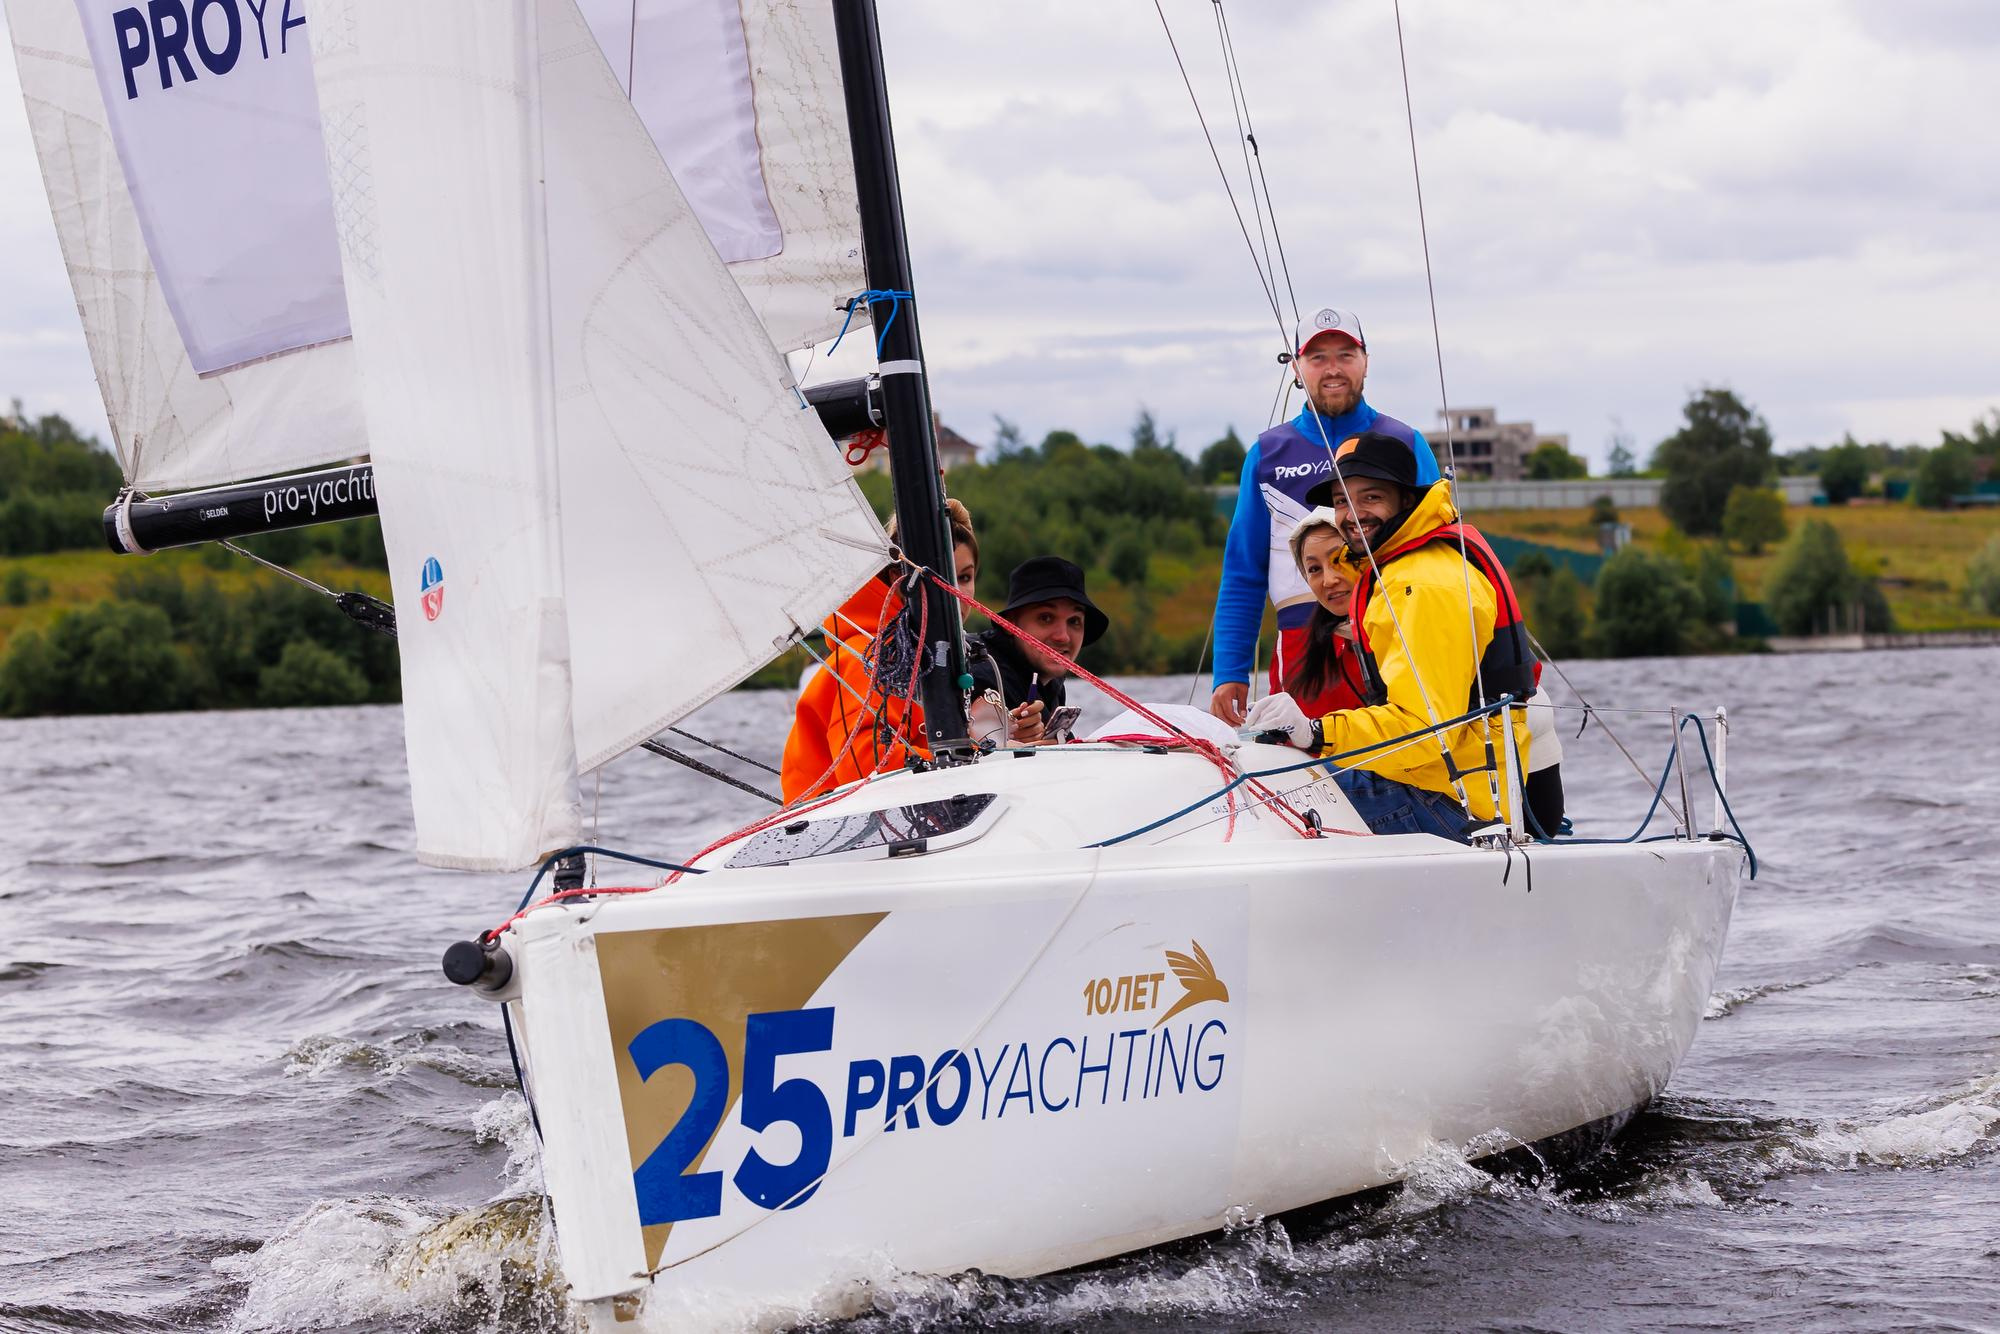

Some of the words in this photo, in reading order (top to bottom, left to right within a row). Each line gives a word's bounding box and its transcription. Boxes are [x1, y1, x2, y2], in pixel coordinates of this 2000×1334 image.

[847, 249, 858, 258] 25
[1275, 459, 1335, 480] PROYA
[844, 1019, 1228, 1138] PROYACHTING
[628, 1006, 835, 1226] 25
